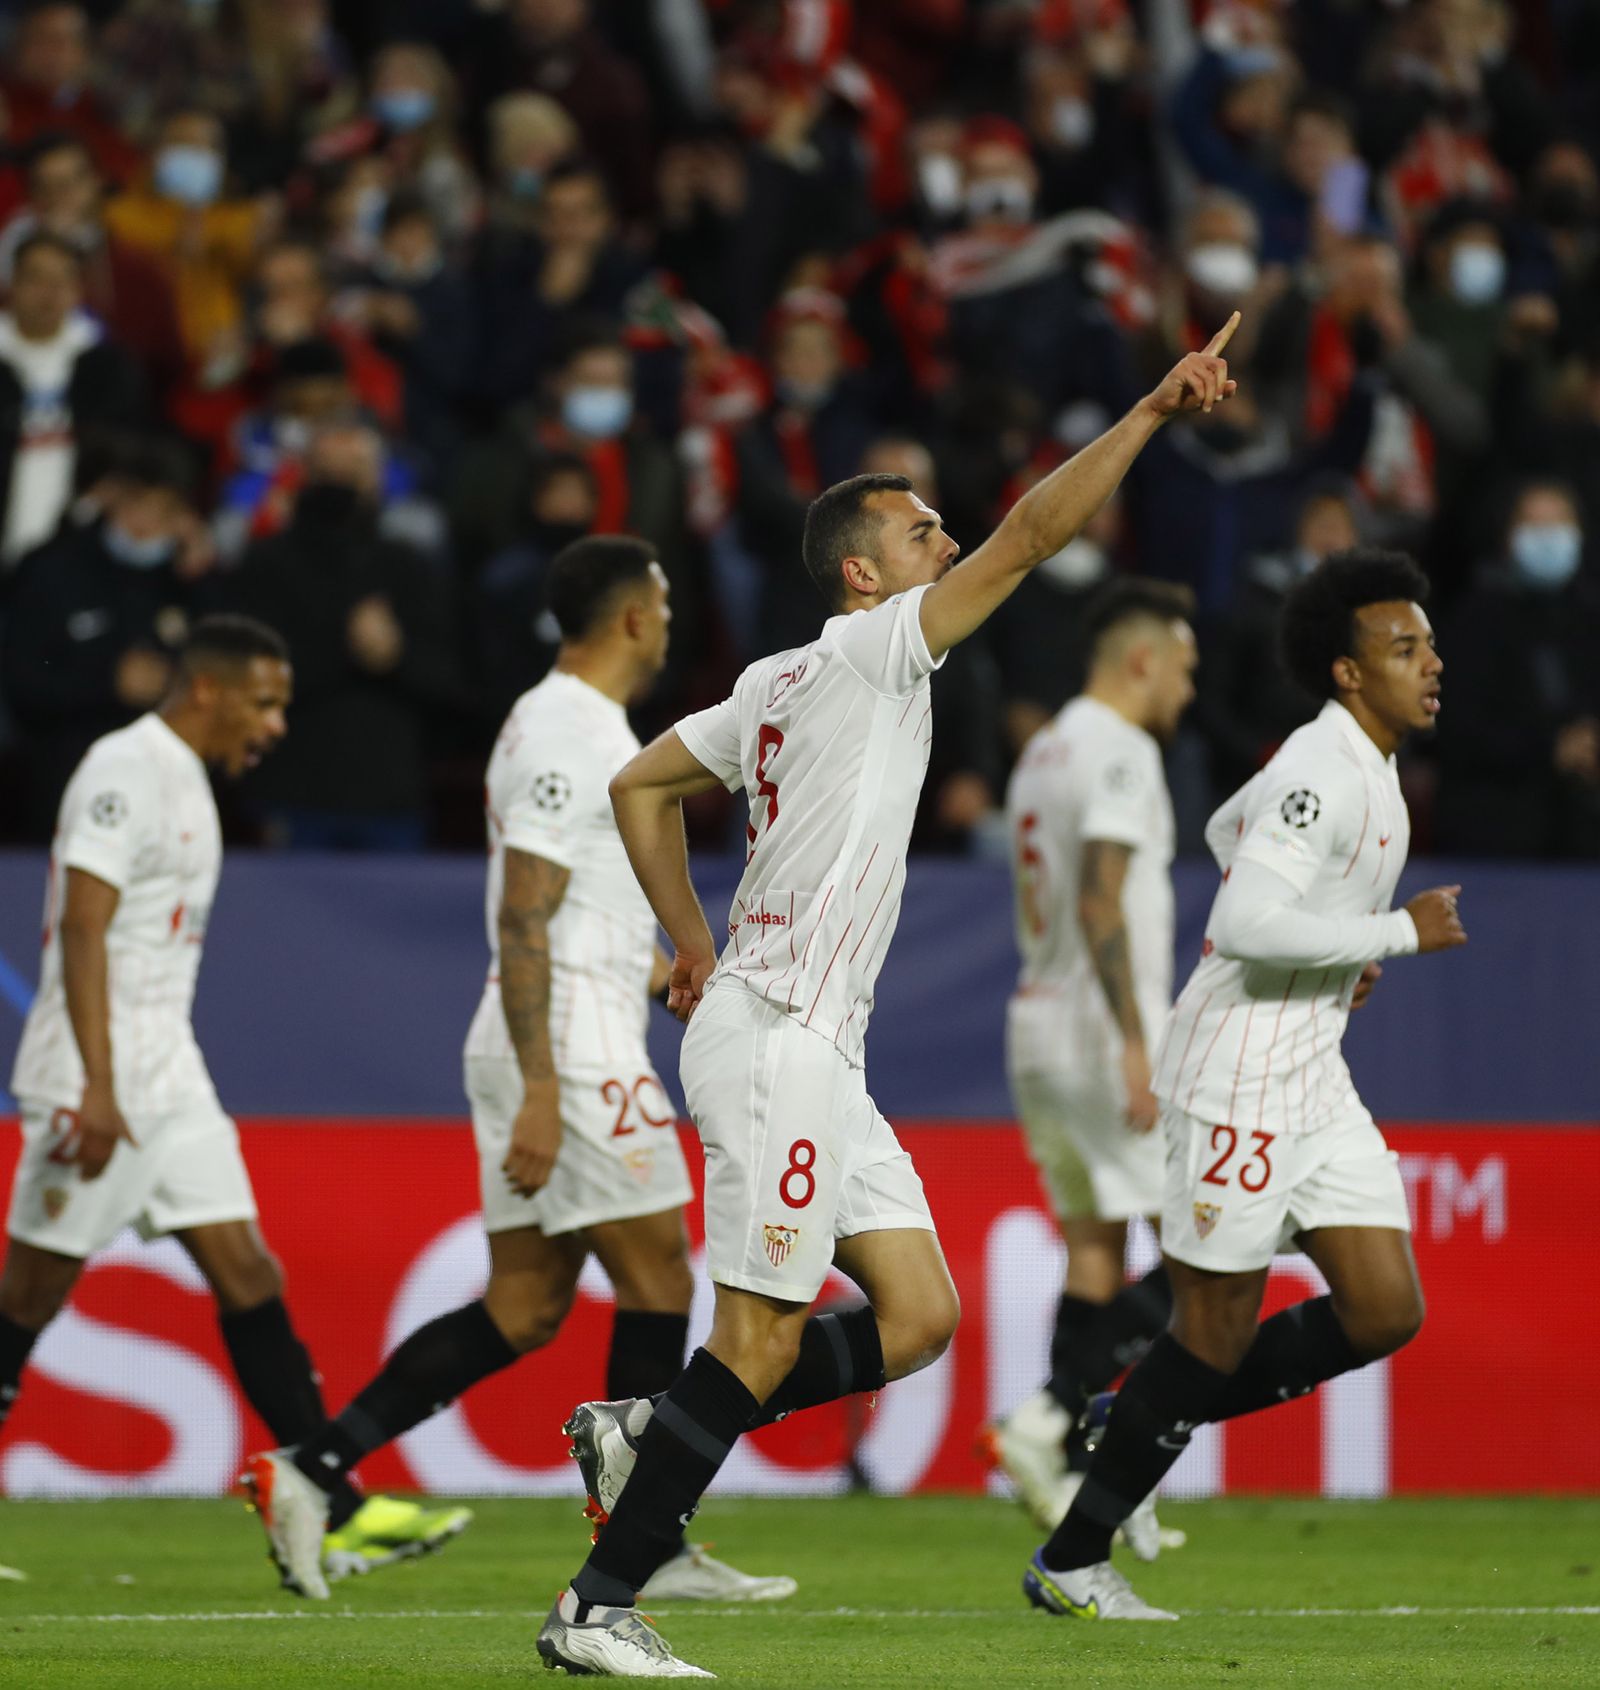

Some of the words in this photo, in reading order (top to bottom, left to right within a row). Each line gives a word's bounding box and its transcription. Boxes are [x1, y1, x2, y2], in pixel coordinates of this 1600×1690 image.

[743, 912, 787, 926] nidas
[47, 1106, 83, 1167] 2
[599, 1075, 675, 1137] 20
[779, 1138, 816, 1209] 8
[1200, 1124, 1276, 1193] 23
